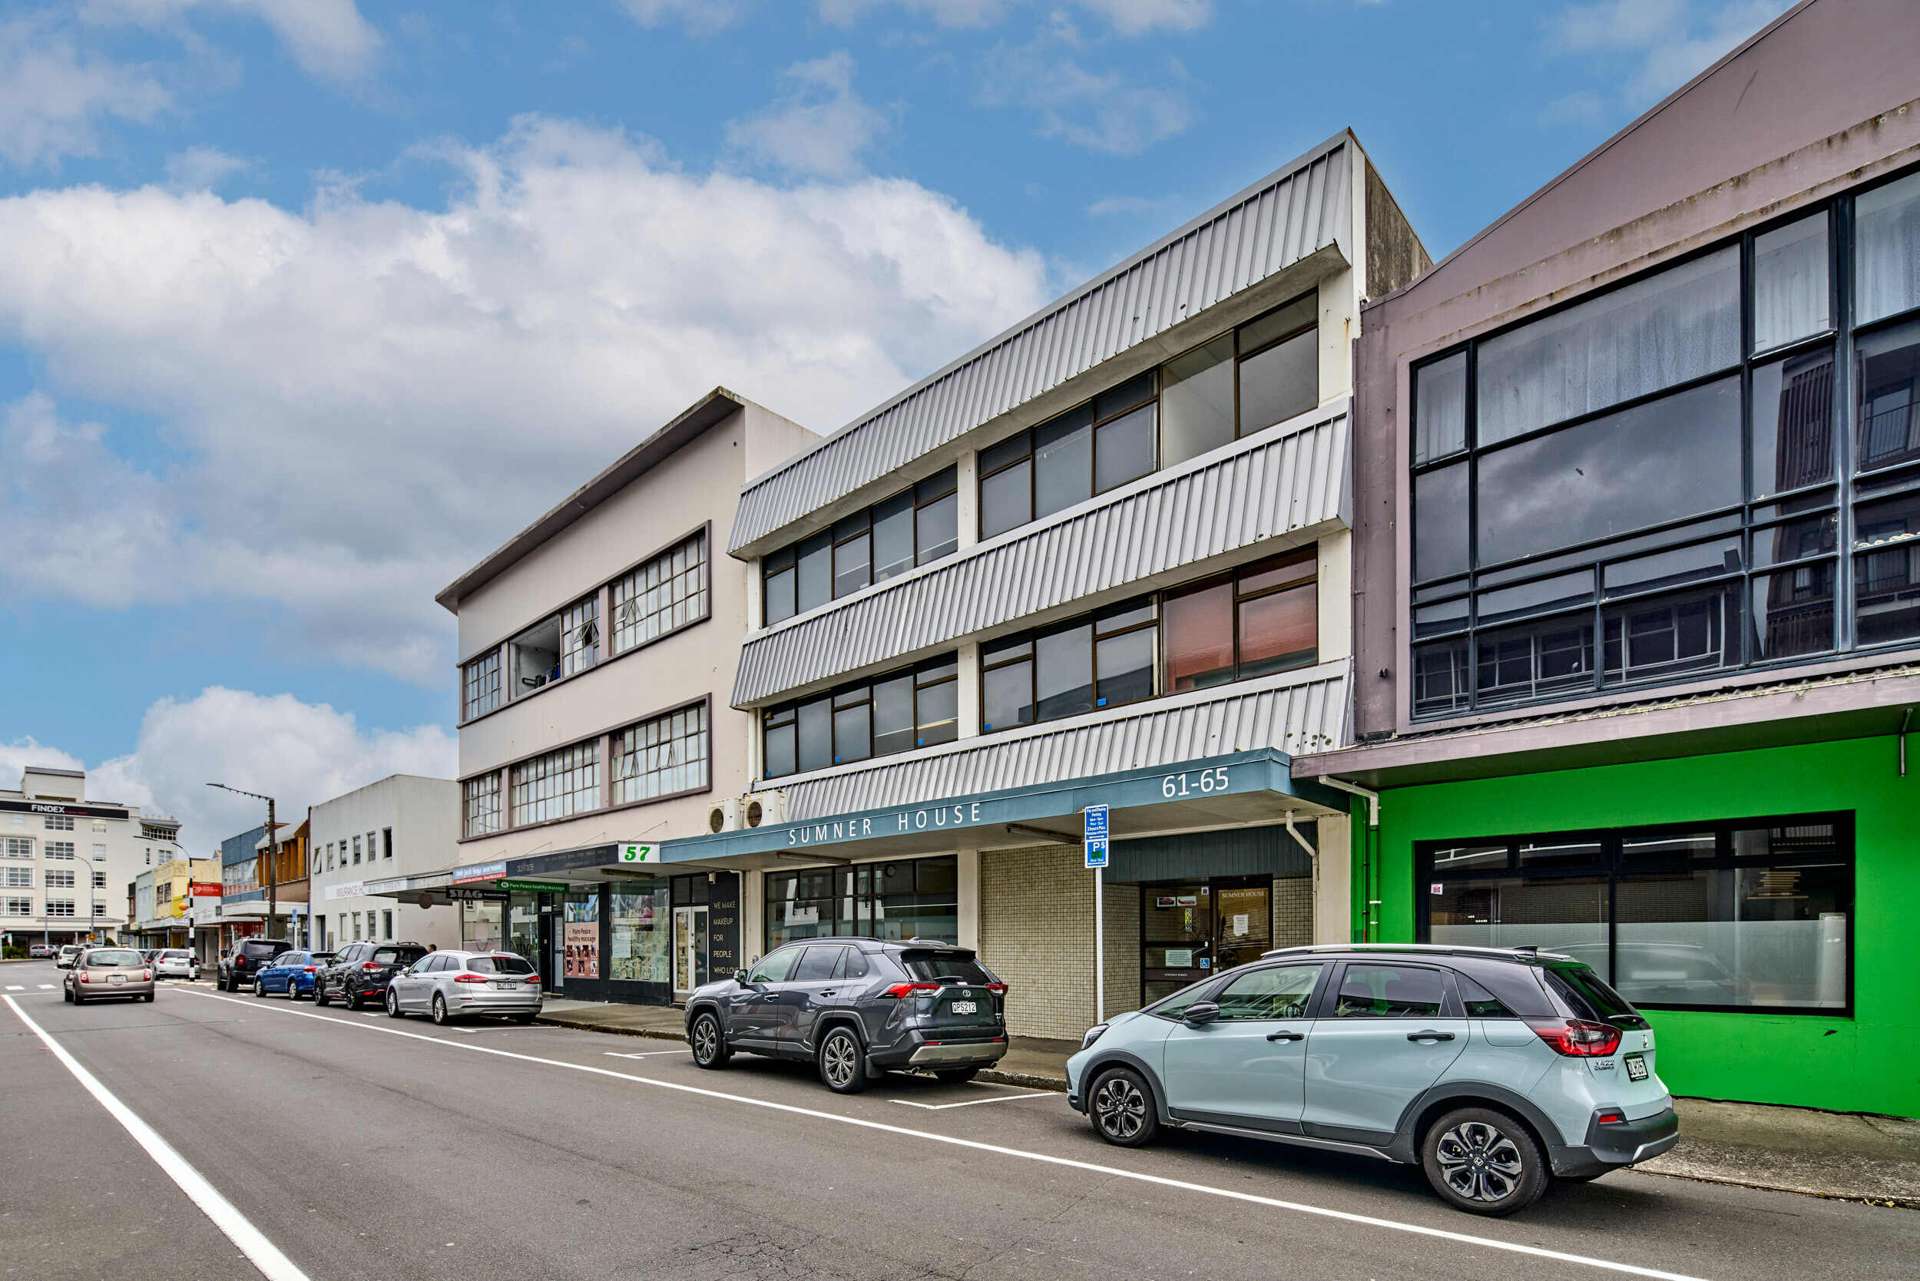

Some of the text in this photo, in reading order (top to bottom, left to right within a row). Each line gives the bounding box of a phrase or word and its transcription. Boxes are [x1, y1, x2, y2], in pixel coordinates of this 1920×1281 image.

[1162, 767, 1230, 798] 61-65
[31, 804, 65, 814] FINDEX
[788, 803, 981, 846] SUMNER HOUSE
[624, 846, 651, 861] 57
[713, 934, 724, 942] FOR
[713, 950, 732, 958] PEOPLE
[713, 967, 726, 975] WHO
